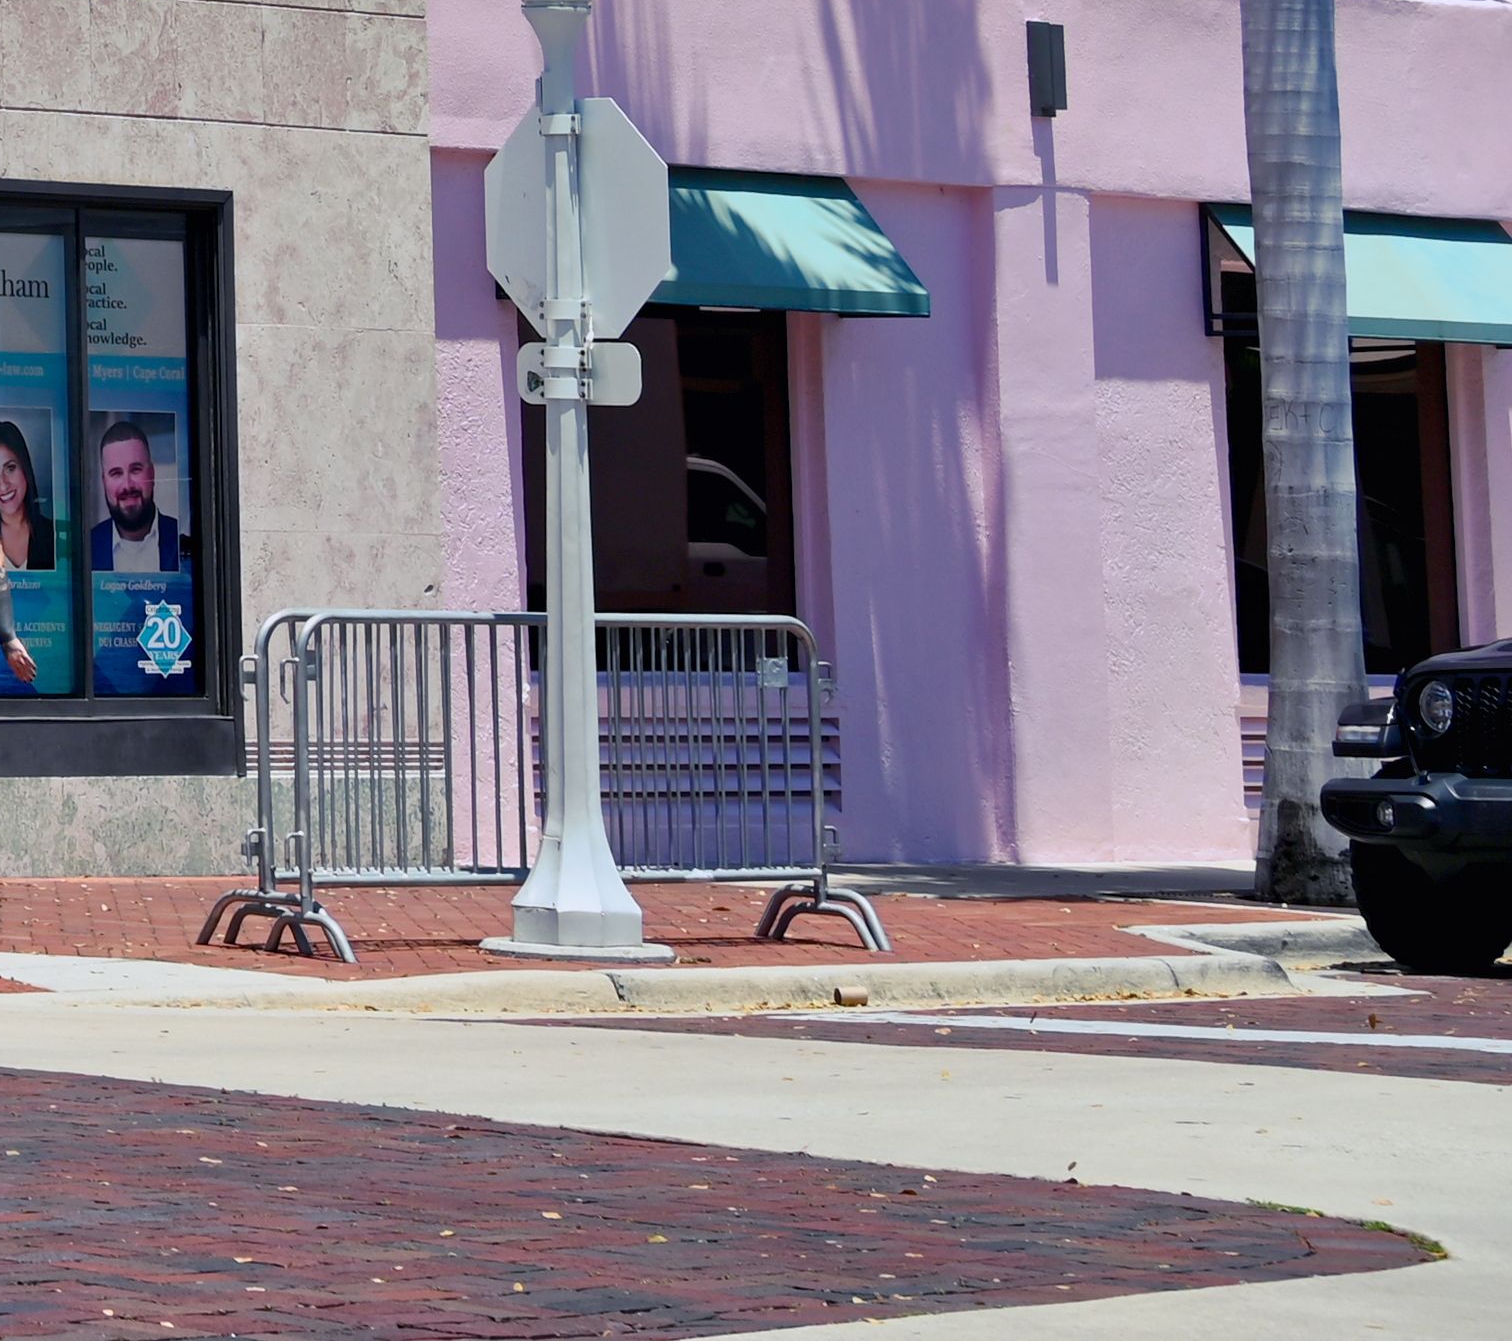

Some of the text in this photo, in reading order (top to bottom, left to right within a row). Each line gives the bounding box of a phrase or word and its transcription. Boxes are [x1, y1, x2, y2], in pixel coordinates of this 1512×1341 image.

[133, 365, 157, 383] Cape
[127, 579, 167, 593] Goldberg
[23, 622, 66, 632] ACCIDENTS
[146, 616, 182, 649] 20
